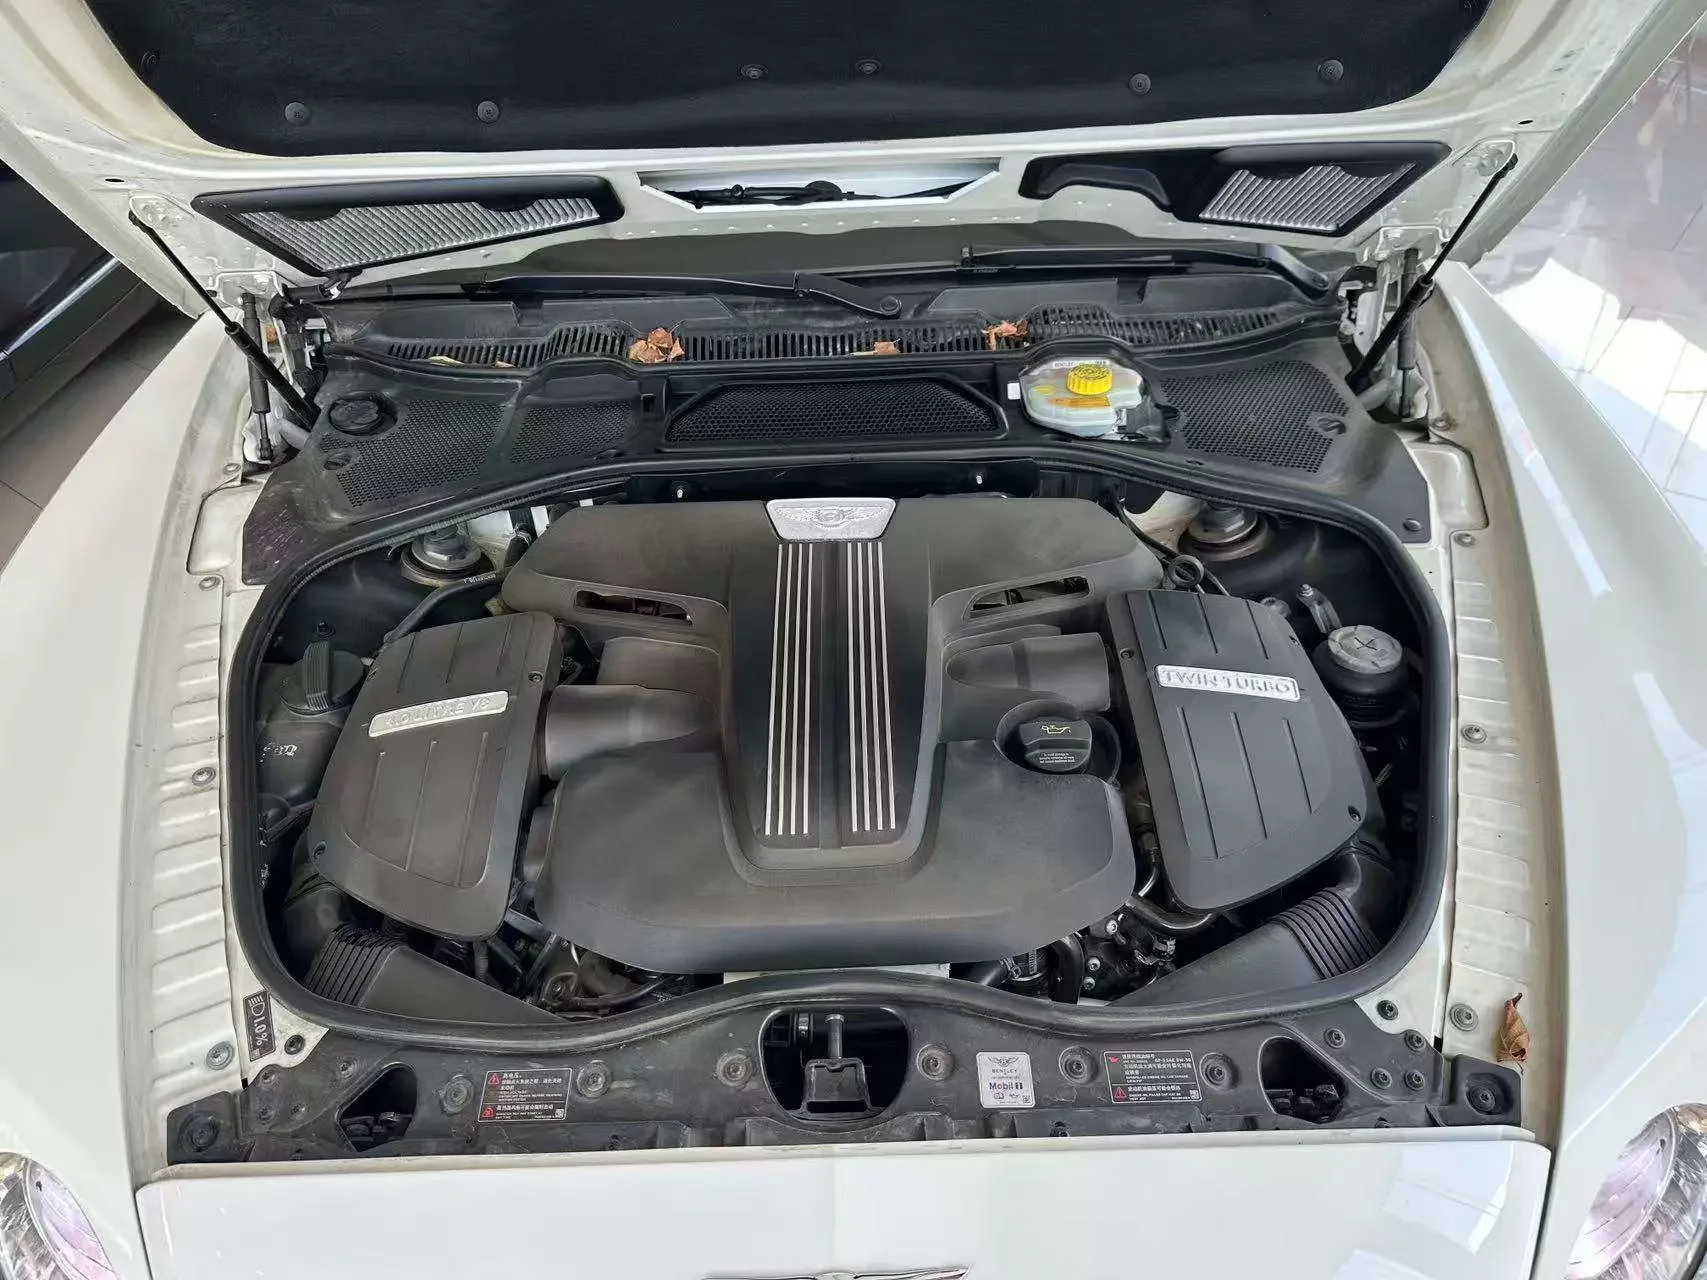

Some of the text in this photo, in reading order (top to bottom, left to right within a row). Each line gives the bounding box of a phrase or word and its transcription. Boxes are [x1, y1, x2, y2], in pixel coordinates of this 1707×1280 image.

[1162, 670, 1290, 693] TWIN TURBO
[989, 1082, 1014, 1090] Mobil
